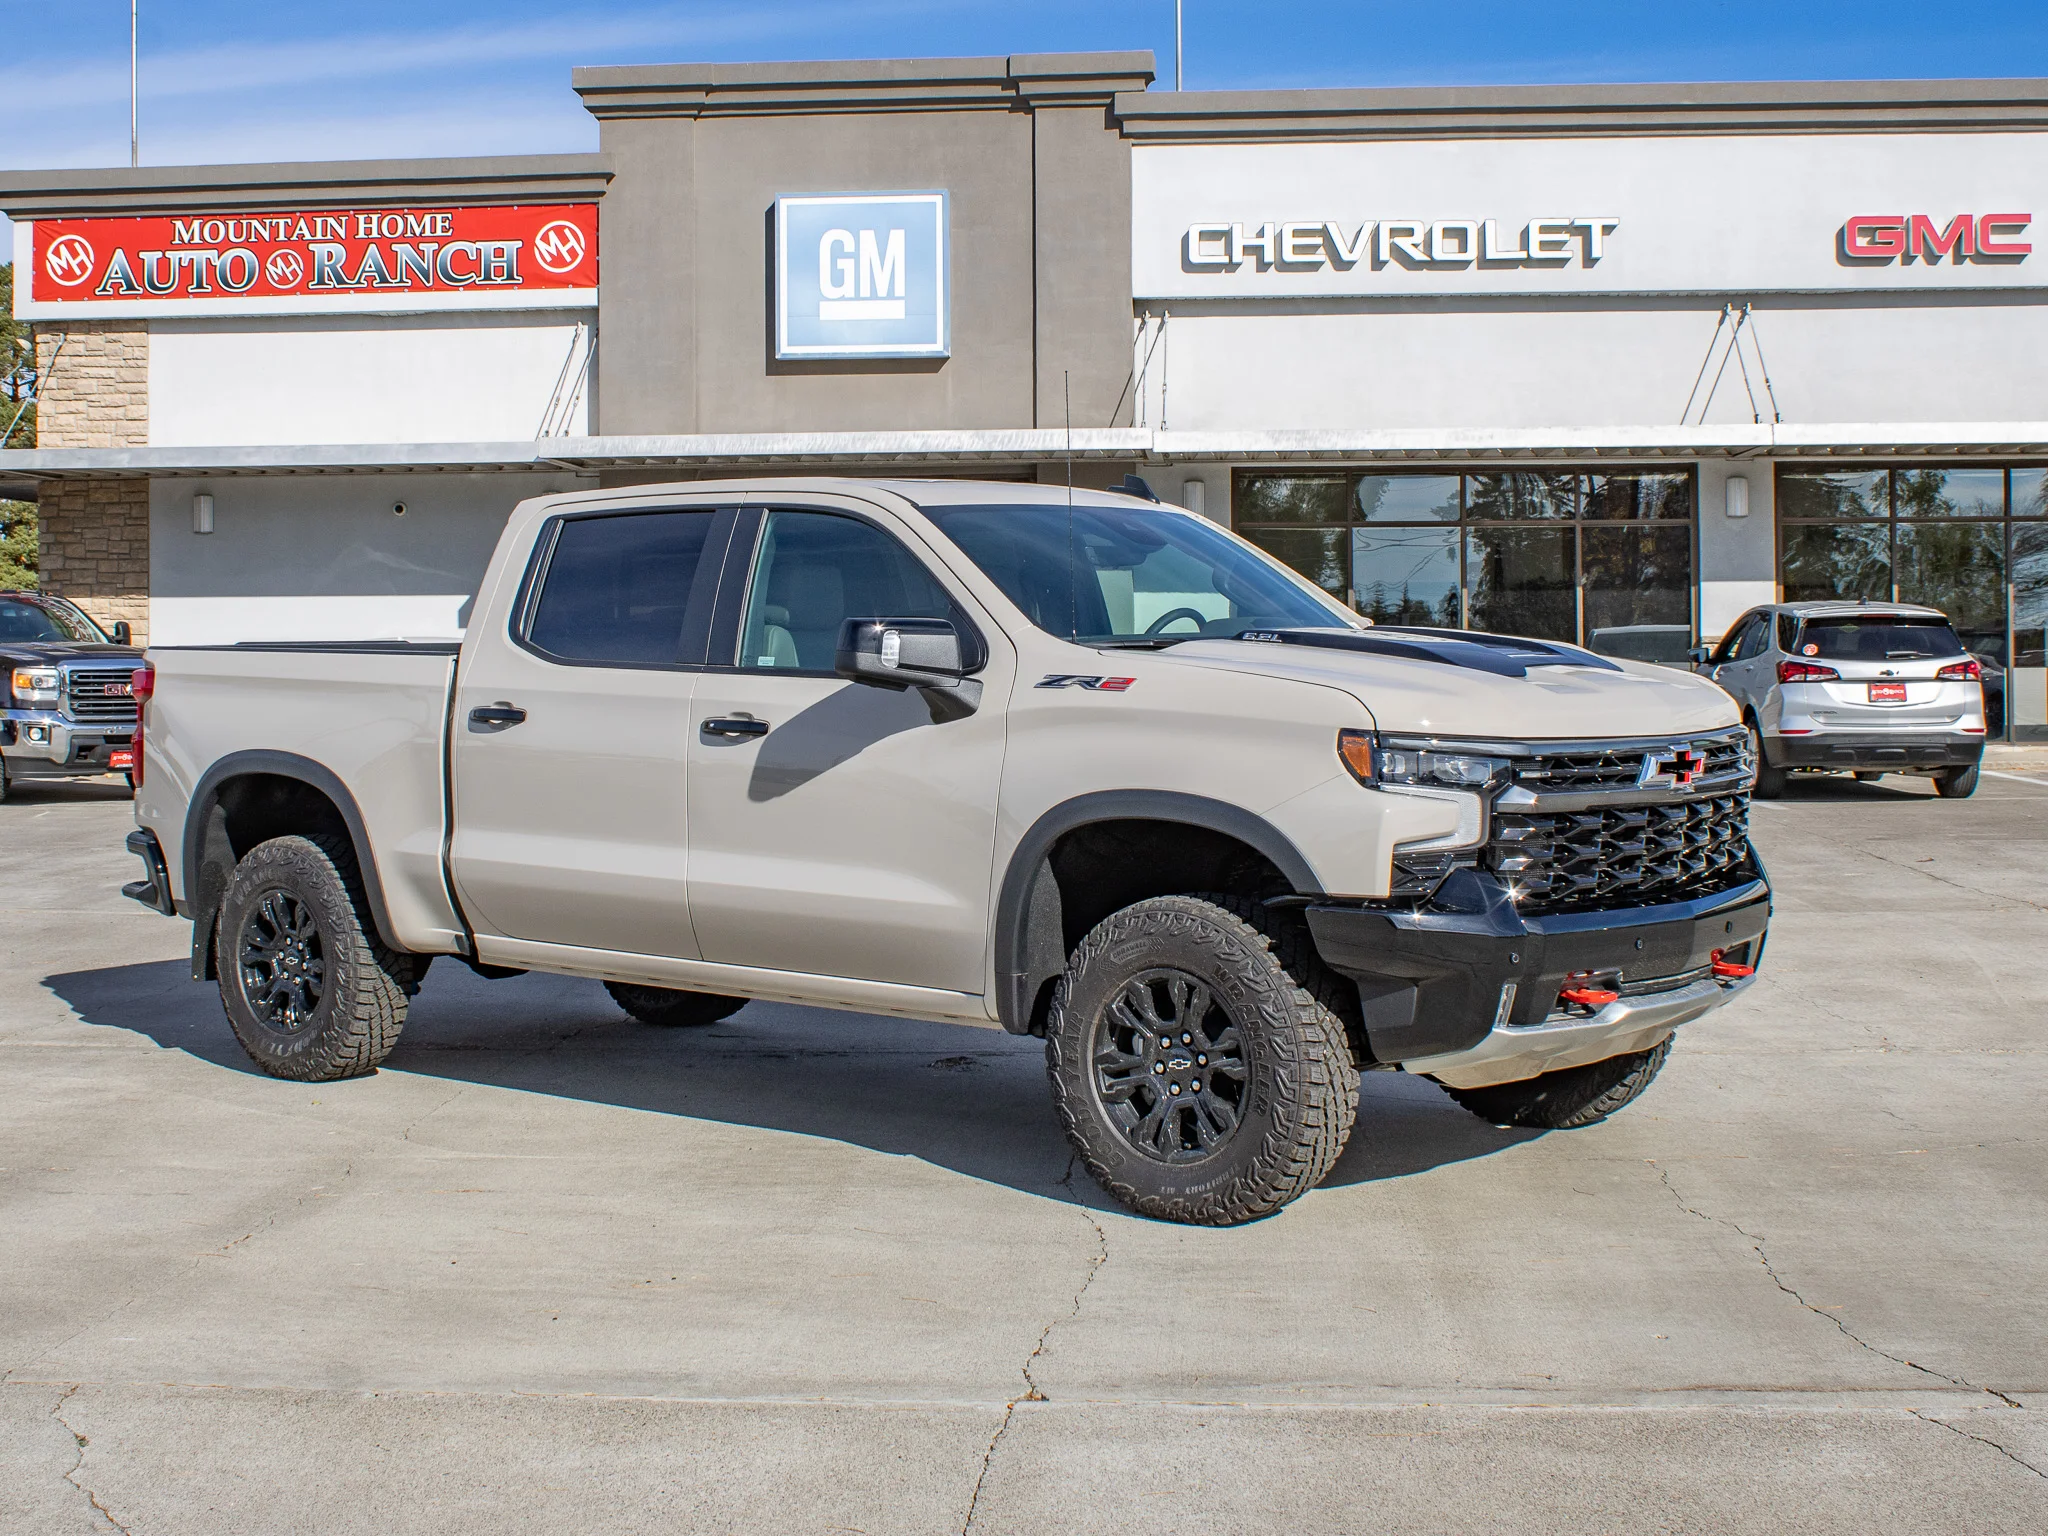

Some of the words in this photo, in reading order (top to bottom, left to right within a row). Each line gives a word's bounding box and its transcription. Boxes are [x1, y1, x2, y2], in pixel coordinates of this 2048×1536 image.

[171, 216, 349, 245] MOUNTAIN
[354, 212, 454, 239] HOME
[1182, 217, 1620, 271] CHEVROLET
[1836, 213, 2032, 267] GMC
[94, 246, 260, 296] AUTO
[307, 240, 524, 289] RANCH
[819, 228, 906, 299] GM
[104, 684, 133, 696] GM
[1033, 674, 1138, 692] ZR2
[1213, 962, 1272, 1117] WRANGLER
